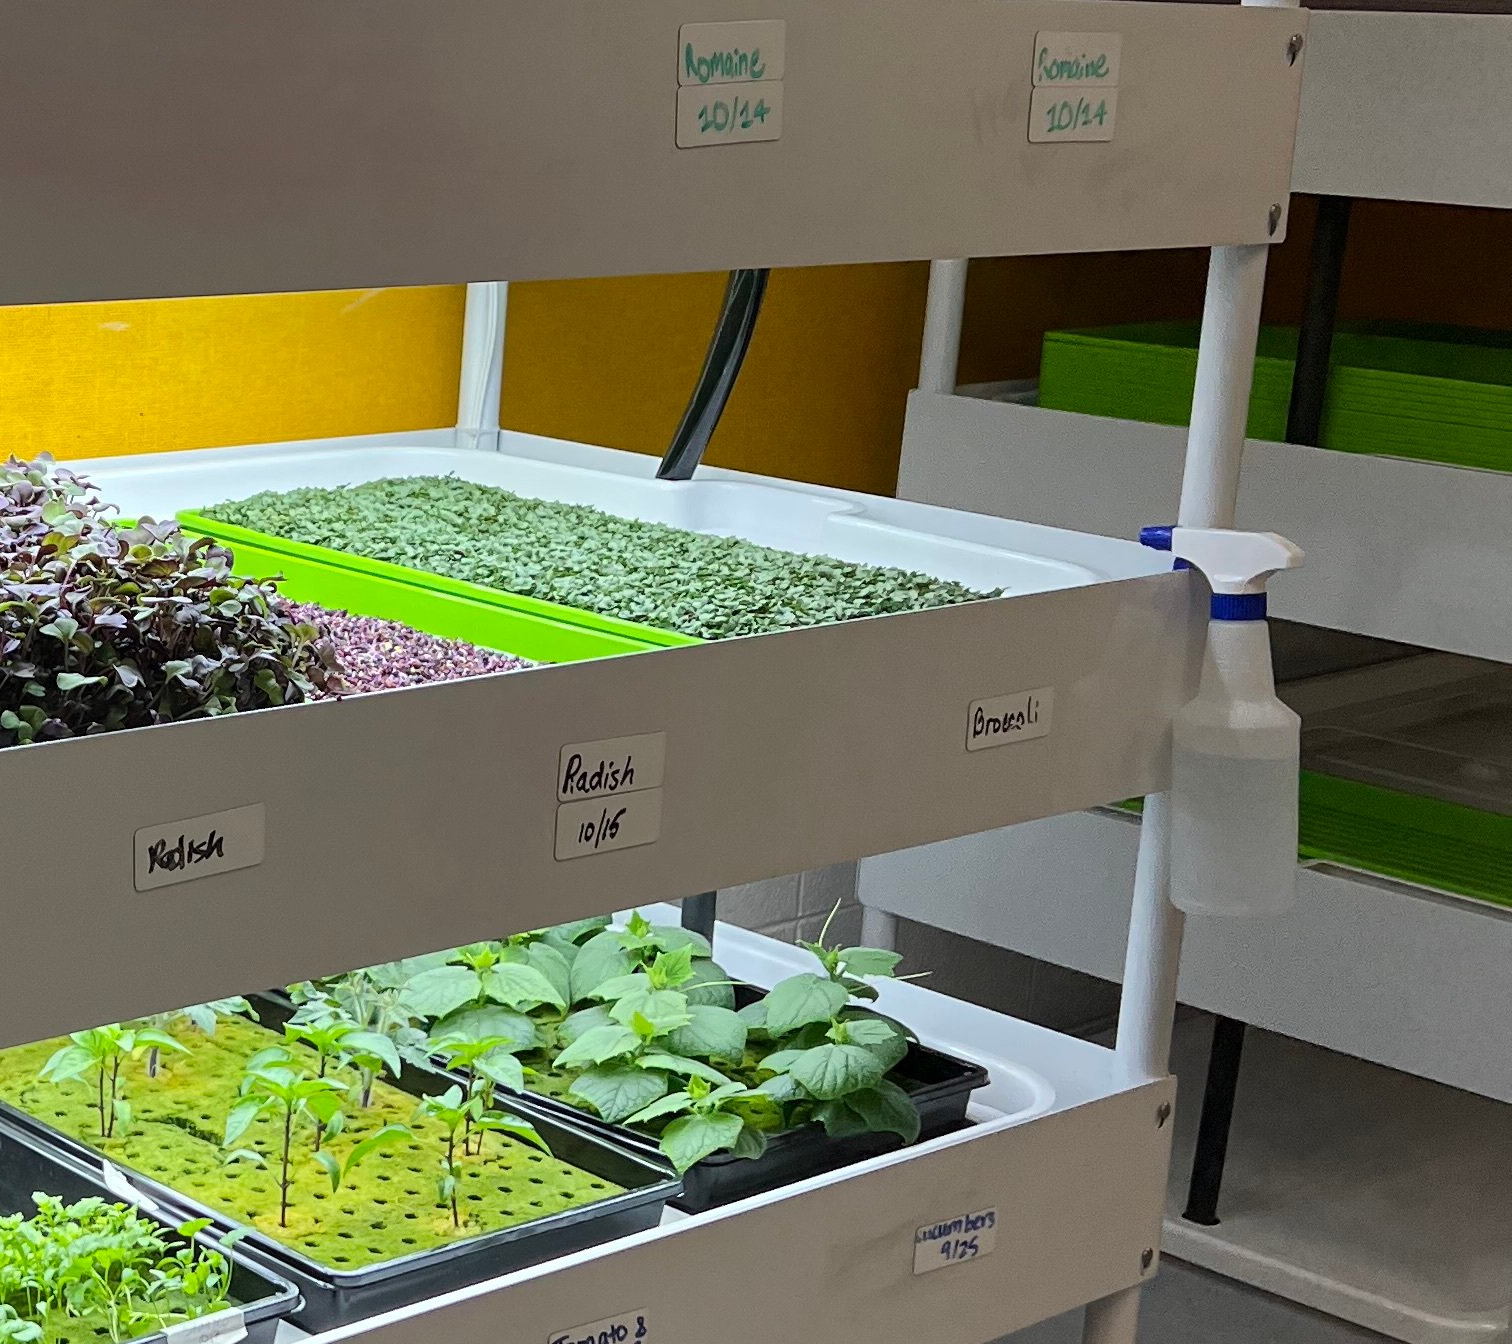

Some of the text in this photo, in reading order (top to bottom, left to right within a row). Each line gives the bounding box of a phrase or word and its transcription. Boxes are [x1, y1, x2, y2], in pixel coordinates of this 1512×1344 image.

[686, 43, 766, 84] Romaine
[698, 96, 771, 133] 10/14
[1046, 97, 1107, 132] 10/14
[562, 754, 634, 794] Radish
[941, 1235, 978, 1260] 9/25
